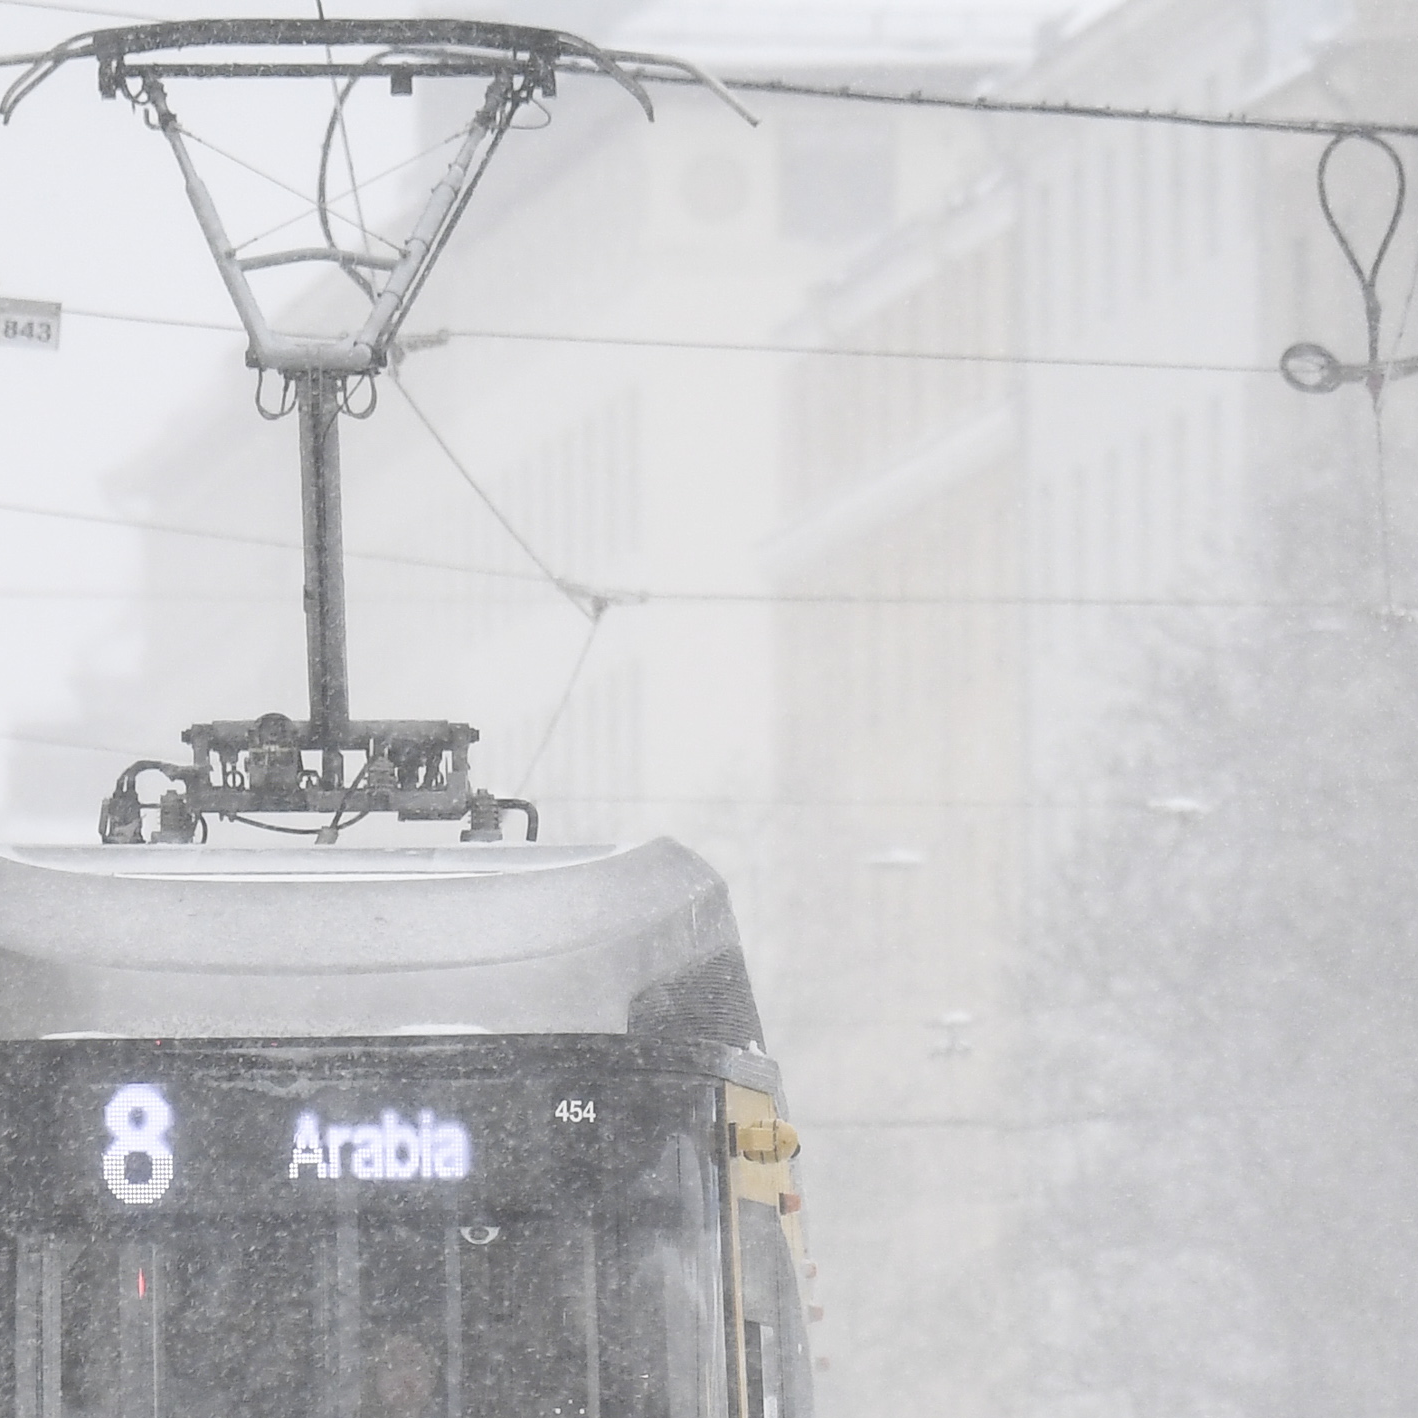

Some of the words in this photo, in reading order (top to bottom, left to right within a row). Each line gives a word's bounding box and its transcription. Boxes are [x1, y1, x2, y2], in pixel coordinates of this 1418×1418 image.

[3, 320, 51, 343] 843
[555, 1101, 595, 1122] 454
[102, 1083, 173, 1203] 8
[289, 1110, 471, 1180] Arabia
